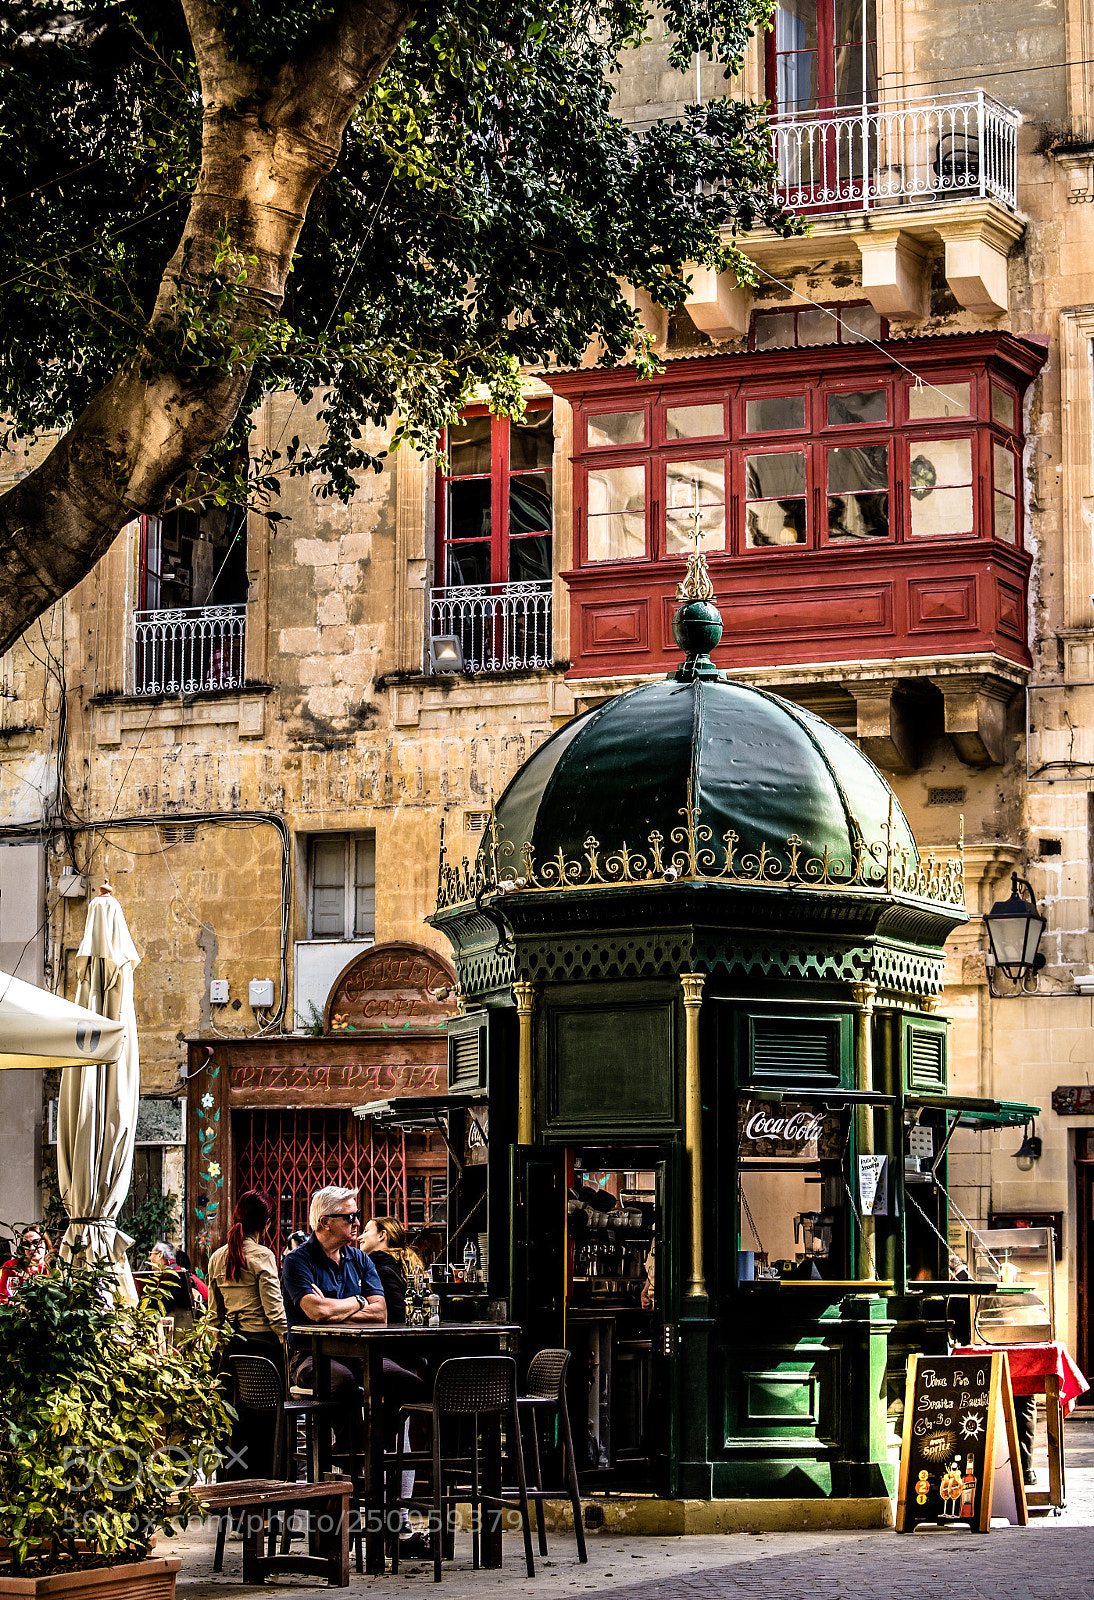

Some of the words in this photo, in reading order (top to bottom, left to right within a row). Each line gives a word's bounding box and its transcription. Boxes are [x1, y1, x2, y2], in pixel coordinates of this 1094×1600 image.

[363, 998, 423, 1019] CAFE
[232, 1064, 331, 1092] PIZZA
[337, 1062, 441, 1092] PASTA
[746, 1111, 826, 1141] Coca-Cola
[921, 1369, 948, 1388] Time
[976, 1369, 986, 1387] A
[923, 1442, 951, 1456] Spritz
[918, 1481, 927, 1493] 2
